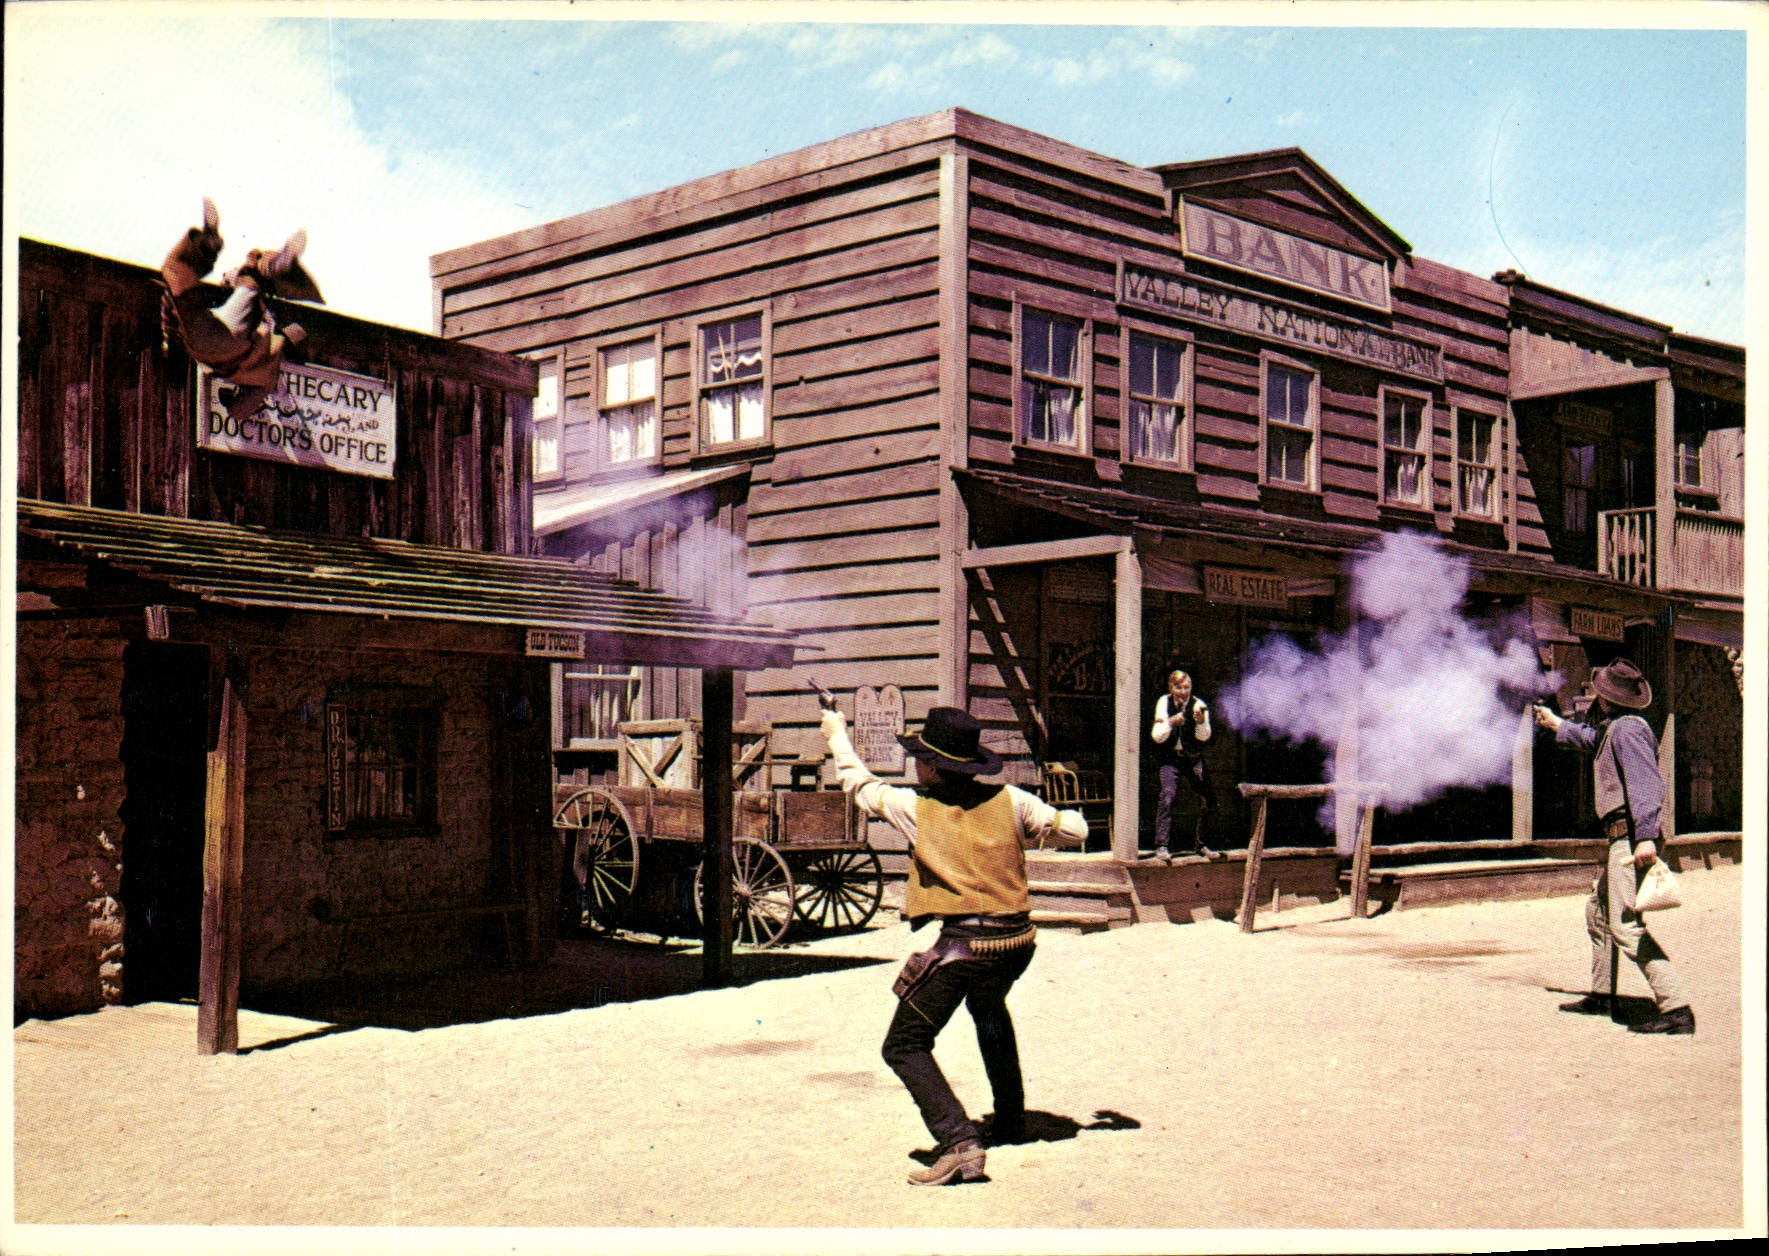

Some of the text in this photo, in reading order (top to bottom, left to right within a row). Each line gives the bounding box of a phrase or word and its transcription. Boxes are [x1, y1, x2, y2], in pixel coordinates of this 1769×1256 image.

[1124, 272, 1436, 373] VALLEY NATIONAL BANK
[209, 411, 388, 464] DOCTOR'S OFFICE
[357, 418, 380, 433] AND
[1208, 572, 1284, 602] REAL ESTATE
[531, 632, 580, 652] OLD TUCSON
